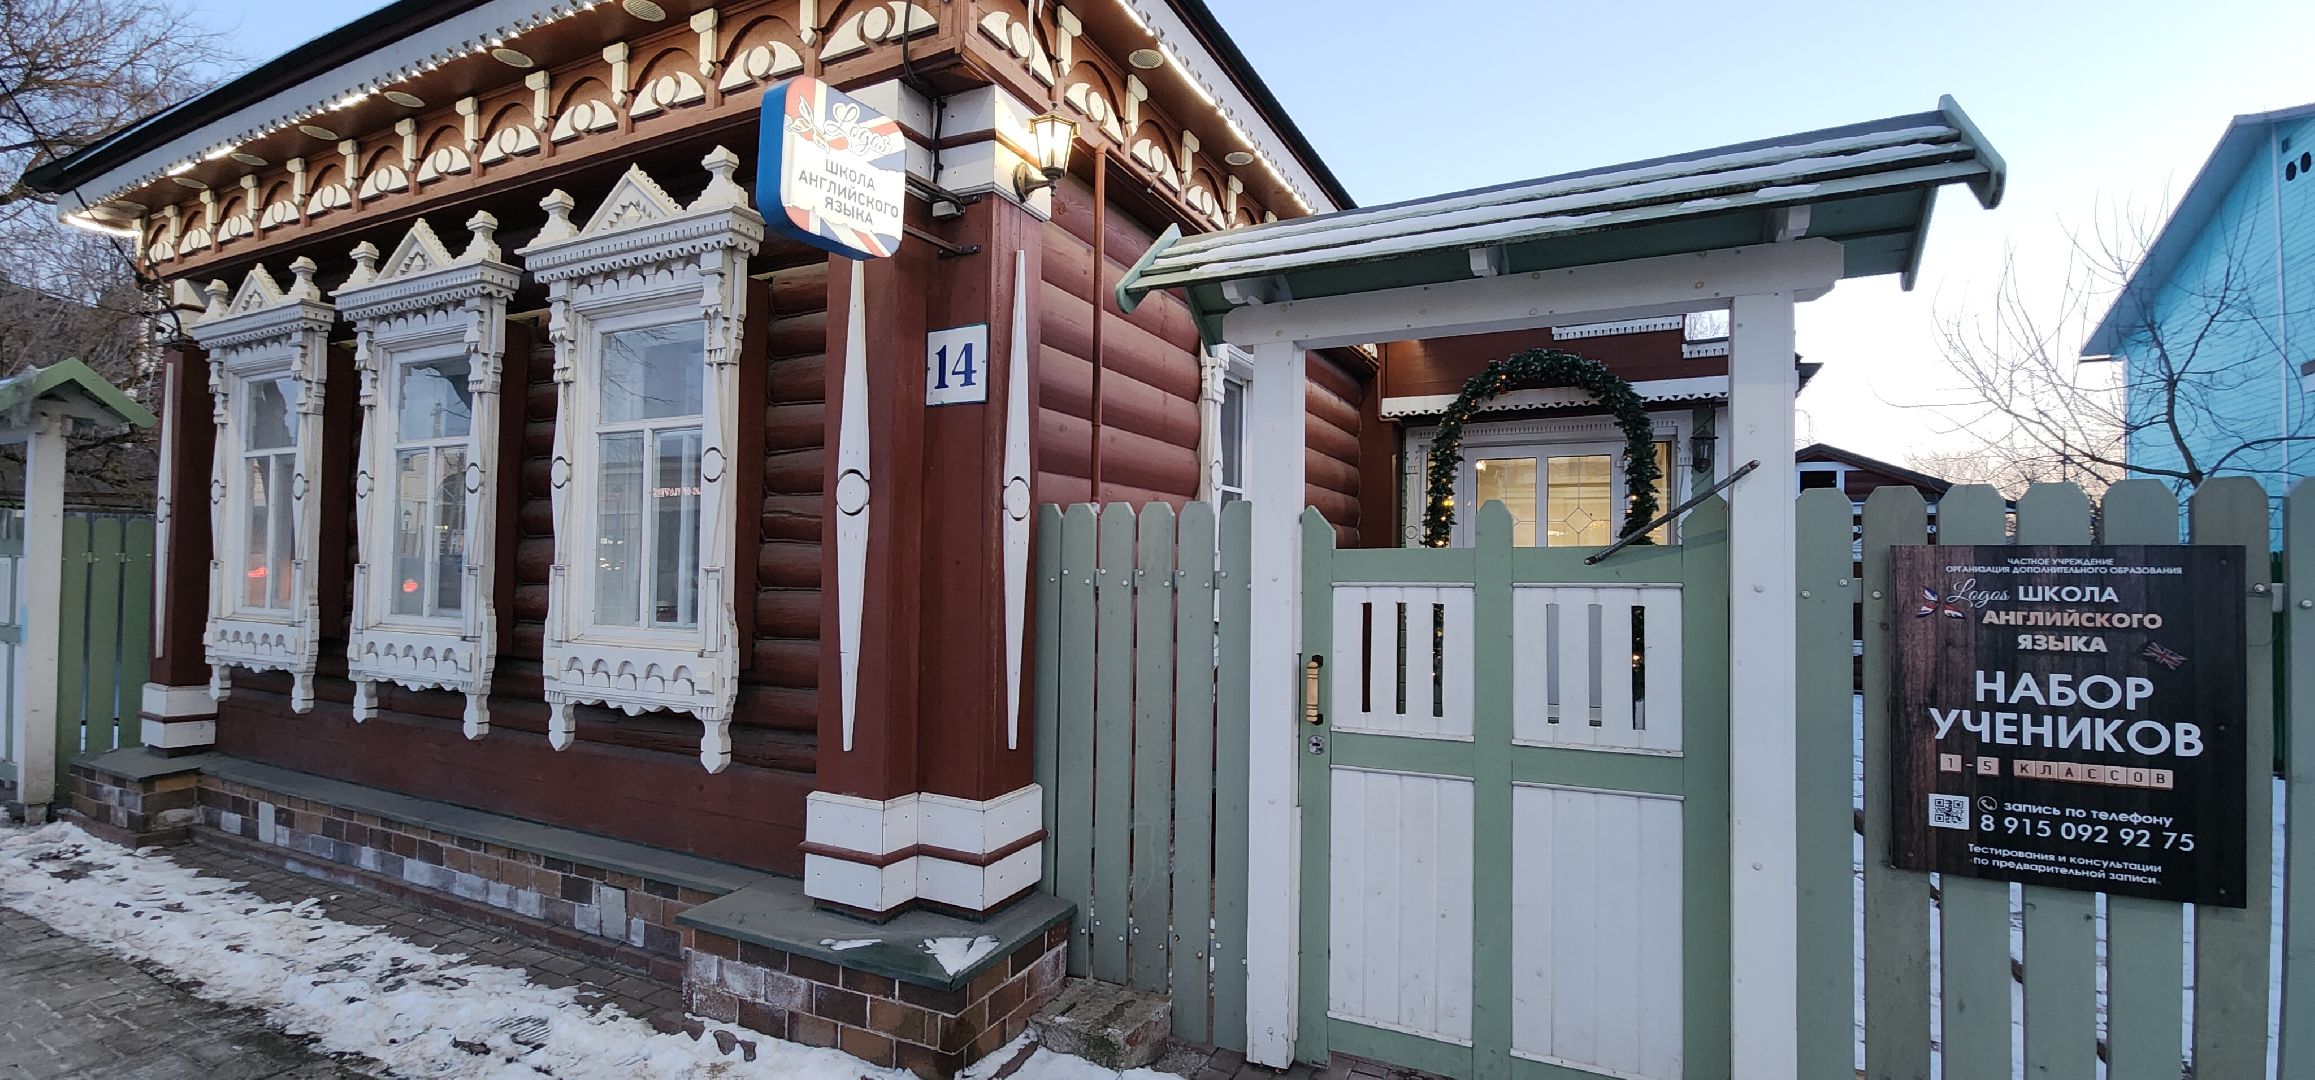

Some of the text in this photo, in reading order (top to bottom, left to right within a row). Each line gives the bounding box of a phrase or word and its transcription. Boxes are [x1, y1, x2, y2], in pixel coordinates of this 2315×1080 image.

[825, 103, 891, 154] Logos
[825, 159, 875, 191] ШКОЛА
[799, 169, 899, 218] АНГЛИЙСКОГО
[825, 196, 873, 225] ЯЗЫКА
[934, 343, 977, 389] 14
[1946, 565, 2183, 575] ОРГАНИЗАЦИЯ ДОПОЛНИТЕЛЬНОГО ОБРАЗОВАНИЯ
[2007, 557, 2114, 566] ЧАСТНОЕ УЧРЕЖДЕНИЕ
[1946, 578, 2119, 608] Logos ШКОЛА
[1982, 608, 2163, 630] АНГЛИЙСКОГО
[2017, 634, 2108, 653] ЯЗЫКА
[1976, 670, 2154, 710] НАБОР
[1928, 707, 2204, 757] УЧЕНИКОВ
[2018, 762, 2167, 784] КЛАССОВ
[2004, 802, 2173, 828] запись по телефону
[1980, 814, 2195, 852] 8 915 092 92 75
[1967, 843, 2162, 874] Тестирования и консультации
[1973, 857, 1989, 866] по
[1992, 859, 2106, 879] предварительной
